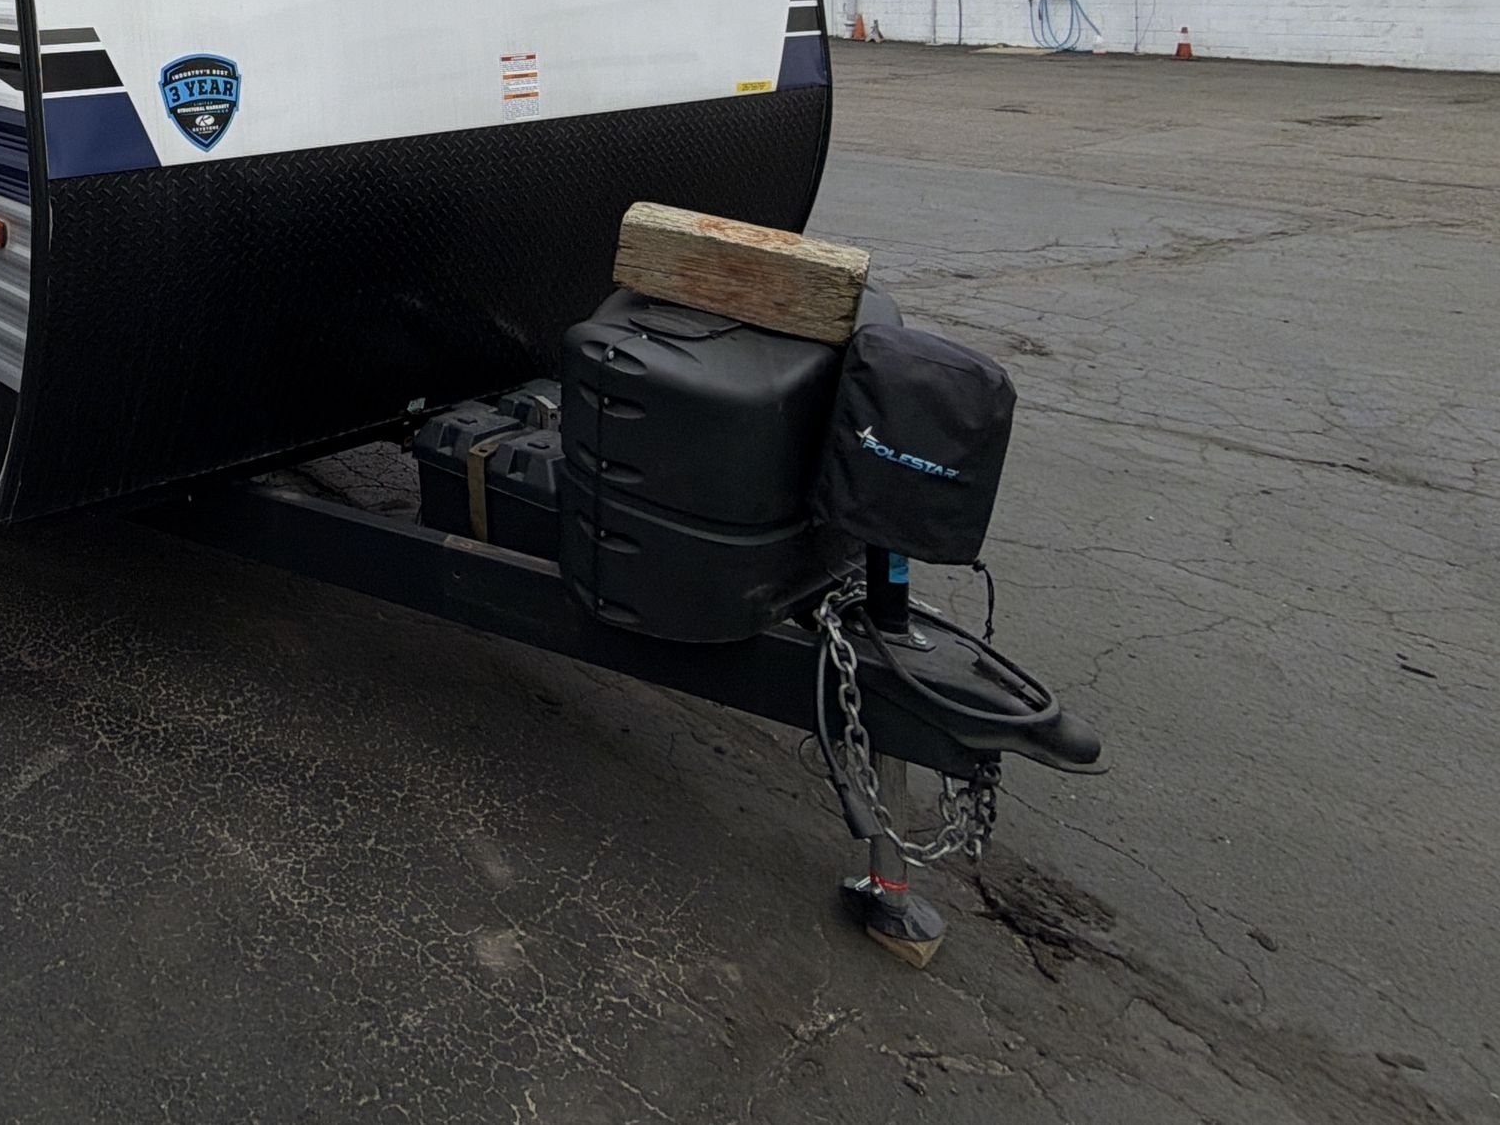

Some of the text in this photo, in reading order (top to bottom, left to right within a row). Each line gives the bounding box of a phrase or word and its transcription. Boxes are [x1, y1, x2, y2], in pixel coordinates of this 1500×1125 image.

[169, 79, 233, 103] 3 YEAR
[862, 438, 957, 479] POLESTAR
